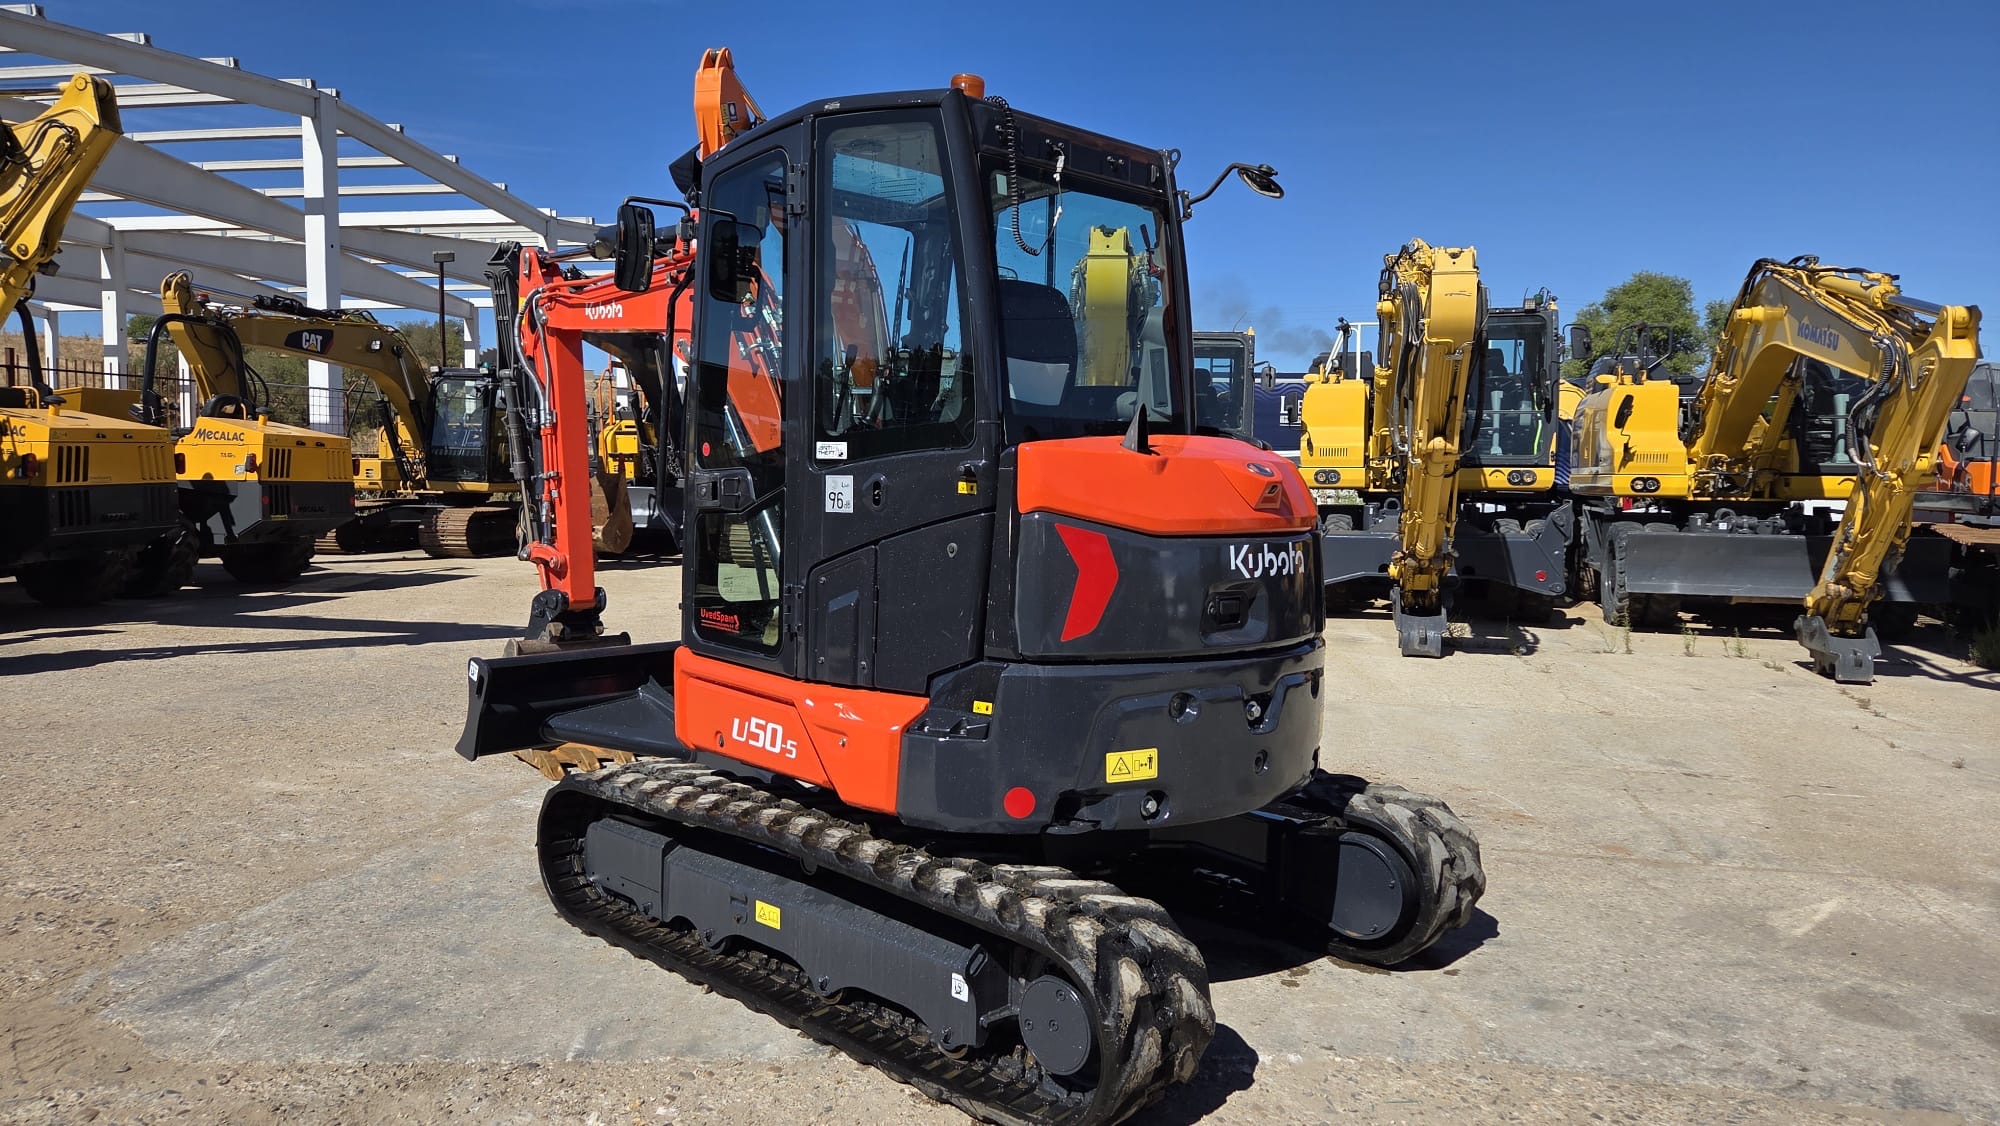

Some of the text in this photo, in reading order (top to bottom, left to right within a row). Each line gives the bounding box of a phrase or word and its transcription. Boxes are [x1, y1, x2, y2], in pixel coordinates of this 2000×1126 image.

[585, 301, 623, 320] Kubota
[302, 331, 323, 352] CAT
[1797, 320, 1840, 351] KOMATSU
[829, 492, 844, 509] 96
[1229, 541, 1305, 579] Kubota
